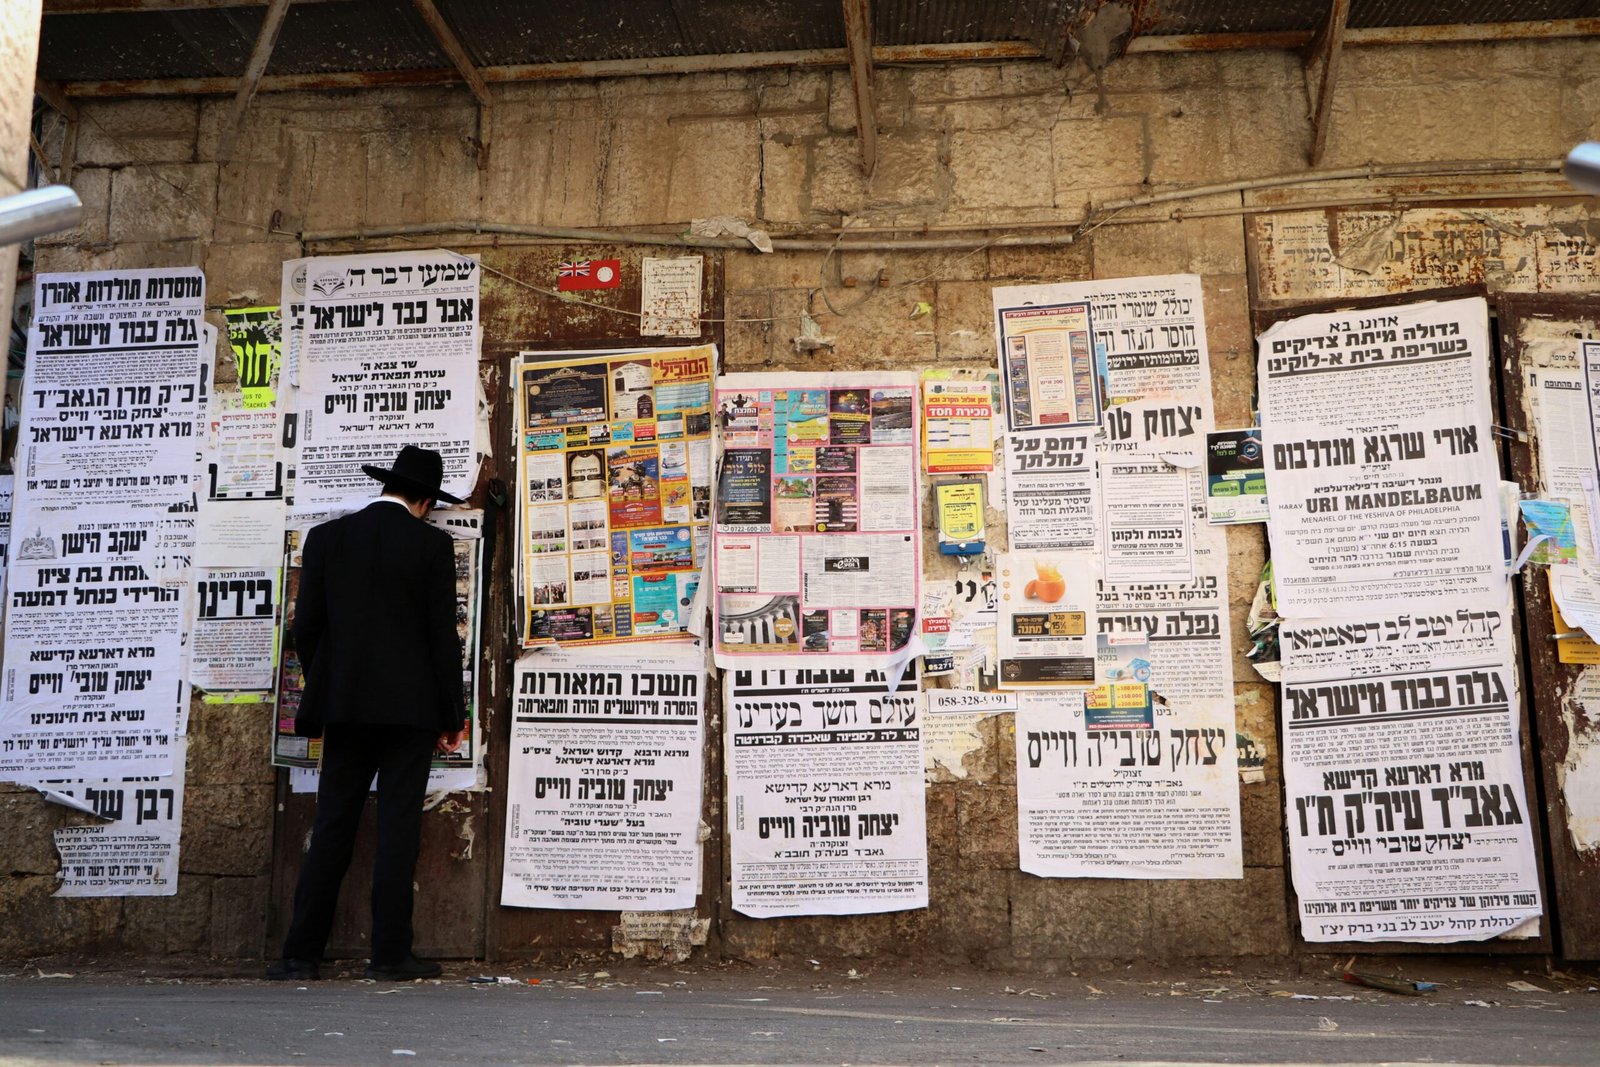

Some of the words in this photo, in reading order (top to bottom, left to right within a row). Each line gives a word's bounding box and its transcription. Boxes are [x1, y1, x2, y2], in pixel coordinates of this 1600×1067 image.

[372, 266, 413, 285] דבר
[418, 262, 476, 287] שמעו
[41, 281, 81, 308] אהרן
[85, 278, 142, 302] תולדות
[145, 276, 202, 300] מוסדות
[310, 302, 384, 329] לישראל
[393, 301, 428, 325] כבד
[436, 298, 474, 323] אבל
[1122, 301, 1158, 318] שומרי
[39, 323, 111, 347] מישראל
[119, 321, 158, 343] כבוד
[165, 318, 197, 342] גלה
[1160, 324, 1196, 348] הוסר
[1346, 329, 1396, 347] מיתת
[1403, 322, 1459, 340] גדולה
[1272, 335, 1338, 355] צדיקים
[1391, 339, 1467, 359] כשריפת
[1140, 353, 1181, 367] חומותיך
[1351, 347, 1384, 363] בית
[373, 361, 399, 370] צבא
[402, 360, 418, 369] שר
[332, 372, 368, 384] ישראל
[371, 370, 411, 380] תפארת
[414, 368, 446, 379] עטרת
[117, 386, 151, 407] מרן
[325, 394, 357, 414] ווייס
[363, 391, 407, 413] טוביה
[414, 390, 452, 414] יצחק
[59, 410, 89, 422] ווייס
[131, 408, 168, 422] יצחק
[956, 407, 989, 417] מכירת
[100, 423, 154, 440] דארעא
[159, 421, 192, 437] מרא
[339, 424, 373, 432] דישראל
[378, 423, 409, 431] דארעא
[1143, 406, 1202, 441] יצחק
[30, 426, 95, 442] דישראל
[1434, 425, 1479, 456] אורי
[1010, 436, 1041, 452] על
[1045, 436, 1088, 451] רחם
[1364, 432, 1425, 464] שרגא
[1016, 451, 1084, 470] נחלתך
[1274, 438, 1356, 470] מנדלבום
[116, 477, 138, 487] מרעים
[1030, 498, 1062, 506] מעלינו
[1064, 496, 1091, 504] שיסיר
[1306, 496, 1339, 514] URI
[1345, 484, 1482, 511] MANDELBAUM
[1019, 508, 1036, 516] הזה
[1058, 506, 1086, 514] הגלות
[1301, 515, 1336, 524] MENAHEL
[1364, 510, 1395, 519] YESHIVA
[1408, 506, 1460, 515] PHILADELPHIA
[1112, 530, 1144, 542] ולקונן
[1147, 529, 1183, 540] לבכות
[1374, 531, 1390, 539] שני
[1392, 530, 1405, 538] יום
[1408, 528, 1426, 536] היום
[62, 532, 101, 557] הישן
[108, 530, 147, 554] יעקב
[1389, 540, 1407, 548] 6:15
[1410, 538, 1438, 547] בשעה
[1340, 554, 1358, 562] להר
[1386, 550, 1412, 558] שמגר
[38, 568, 71, 587] ציון
[76, 567, 102, 583] בת
[240, 570, 266, 578] מחובתנו
[13, 590, 68, 607] דמעה
[74, 587, 118, 605] כנחל
[198, 580, 274, 618] בידינו
[1096, 592, 1120, 602] בעל
[1124, 592, 1152, 602] מאיר
[1155, 591, 1175, 600] רבי
[1098, 615, 1159, 638] עטרת
[1166, 612, 1220, 636] נפלה
[1414, 614, 1452, 639] יטב
[1456, 608, 1500, 638] קהל
[1283, 622, 1380, 651] דסאטמאר
[30, 649, 75, 662] קדישא
[78, 647, 124, 660] דארעא
[127, 646, 155, 658] מרא
[29, 673, 63, 694] ווייס
[114, 670, 152, 694] יצחק
[520, 671, 622, 696] המאורות
[631, 673, 697, 697] חשכו
[1456, 671, 1509, 706] גלה
[1286, 681, 1387, 719] מישראל
[1391, 676, 1451, 711] כבוד
[517, 698, 568, 714] ותפארתה
[572, 699, 599, 714] הודה
[603, 699, 659, 715] מירושלים
[663, 701, 698, 716] הוסרה
[868, 695, 916, 727] עולם
[31, 712, 78, 725] חינוכינו
[82, 711, 106, 723] בית
[110, 710, 145, 722] נשיא
[735, 702, 802, 731] בעדינו
[813, 700, 857, 729] חשך
[736, 734, 783, 745] קברניטה
[788, 733, 831, 742] שאבדה
[836, 731, 875, 741] לספינה
[881, 730, 898, 740] לה
[903, 730, 918, 740] אוי
[562, 746, 594, 756] ישראל
[596, 748, 623, 758] קדוש
[1027, 730, 1077, 768] ווייס
[1087, 729, 1161, 766] טוביה
[1170, 727, 1226, 772] יצחק
[1323, 767, 1378, 791] קדישא
[1385, 764, 1442, 786] דארעא
[1449, 761, 1486, 782] מרא
[535, 776, 570, 799] ווייס
[578, 777, 625, 800] טוביה
[633, 779, 674, 803] יצחק
[764, 782, 808, 796] קדישא
[812, 781, 858, 792] דארעא
[863, 780, 891, 791] מרא
[85, 788, 124, 820] של
[136, 788, 174, 825] רבן
[758, 816, 796, 839] ווייס
[802, 814, 850, 838] טוביה
[858, 813, 899, 840] יצחק
[1331, 838, 1371, 857] ווייס
[1424, 832, 1471, 855] יצחק
[108, 864, 120, 876] לנו
[124, 865, 140, 877] יורה
[1304, 900, 1338, 915] אלוקינו
[1422, 896, 1456, 910] צדיקים
[1479, 894, 1510, 910] סילוקן
[1512, 894, 1536, 906] קשה
[1347, 922, 1374, 936] ברק
[1377, 921, 1397, 932] בני
[1400, 918, 1416, 932] לב
[1418, 918, 1445, 931] יטב
[1449, 918, 1476, 931] קהל
